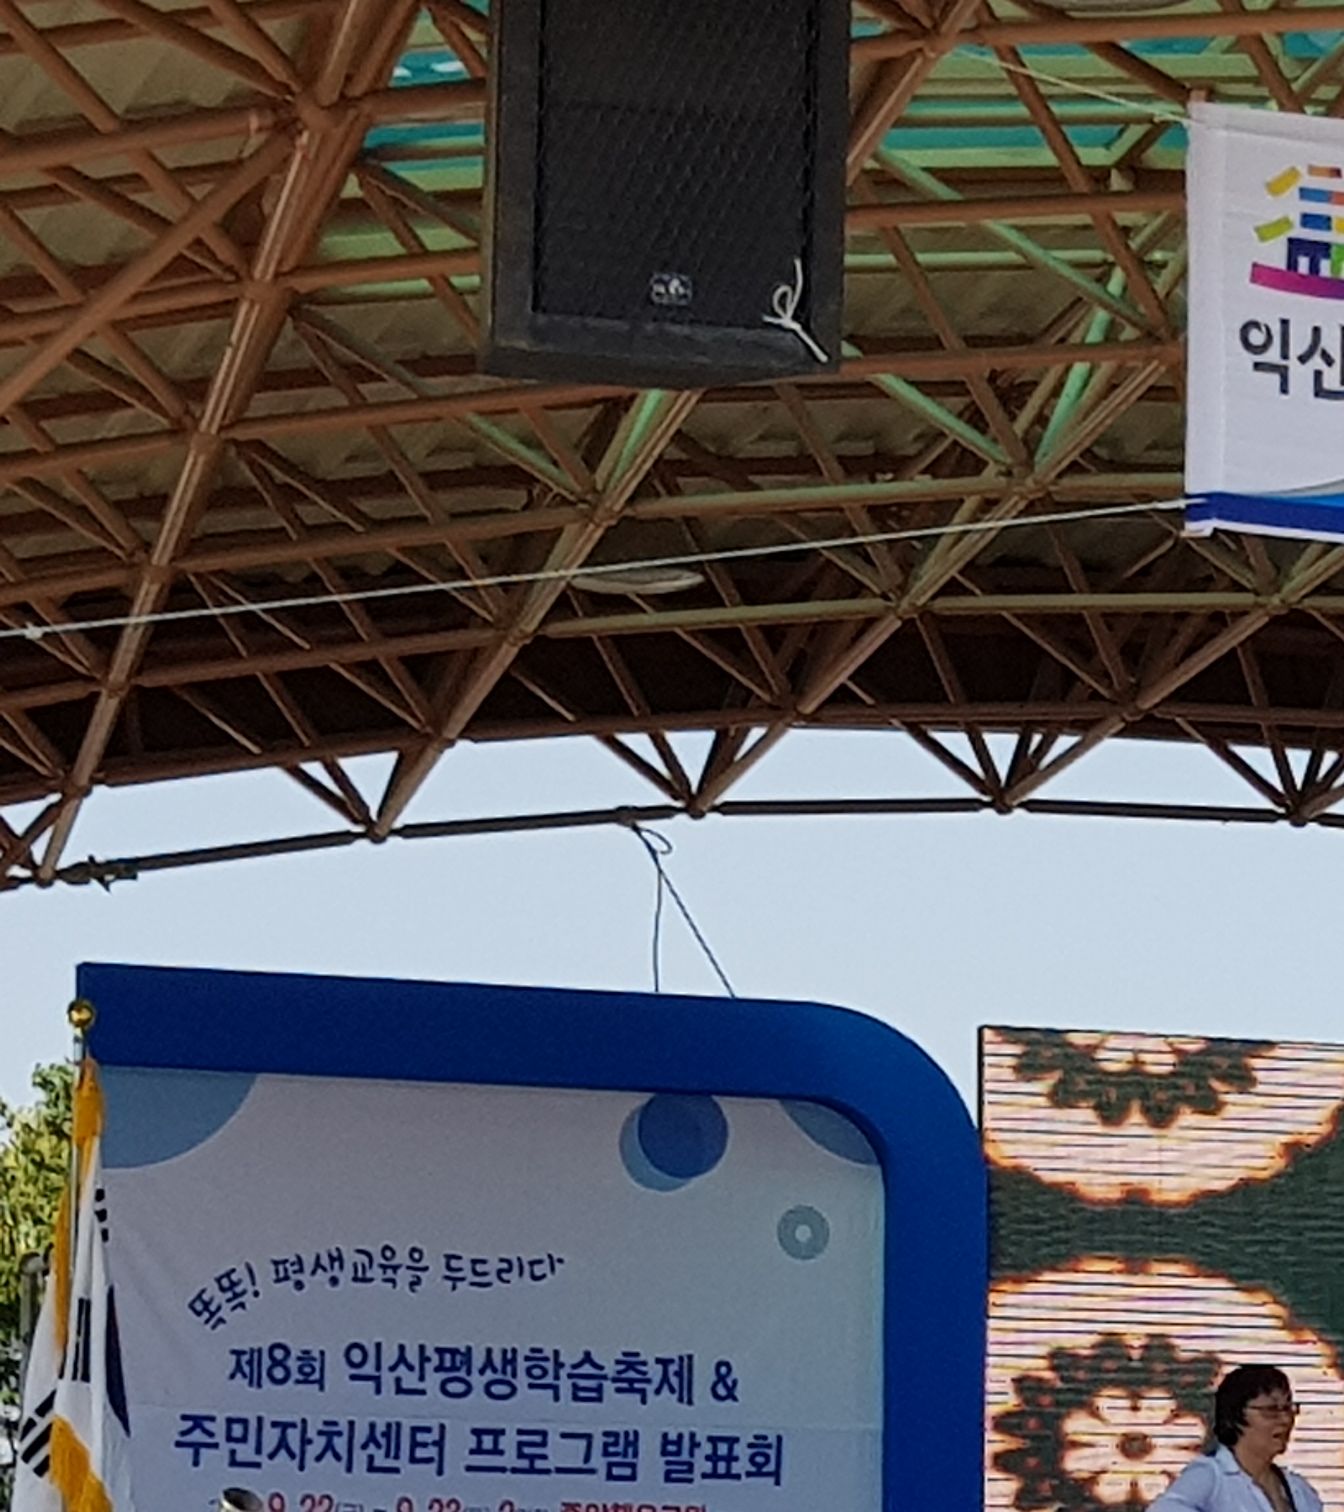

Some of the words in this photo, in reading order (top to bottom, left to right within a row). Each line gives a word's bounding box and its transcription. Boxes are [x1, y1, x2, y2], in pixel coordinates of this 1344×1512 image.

[187, 1262, 261, 1330] 똑똑!
[271, 1243, 430, 1293] 평생교육을
[441, 1252, 566, 1291] 두드리다
[227, 1341, 328, 1392] 제8회
[342, 1341, 695, 1406] 익산평생학습축제
[710, 1360, 740, 1403] &
[173, 1412, 446, 1476] 주민자치센터
[464, 1425, 640, 1483] 프로그램
[660, 1427, 785, 1487] 발표회
